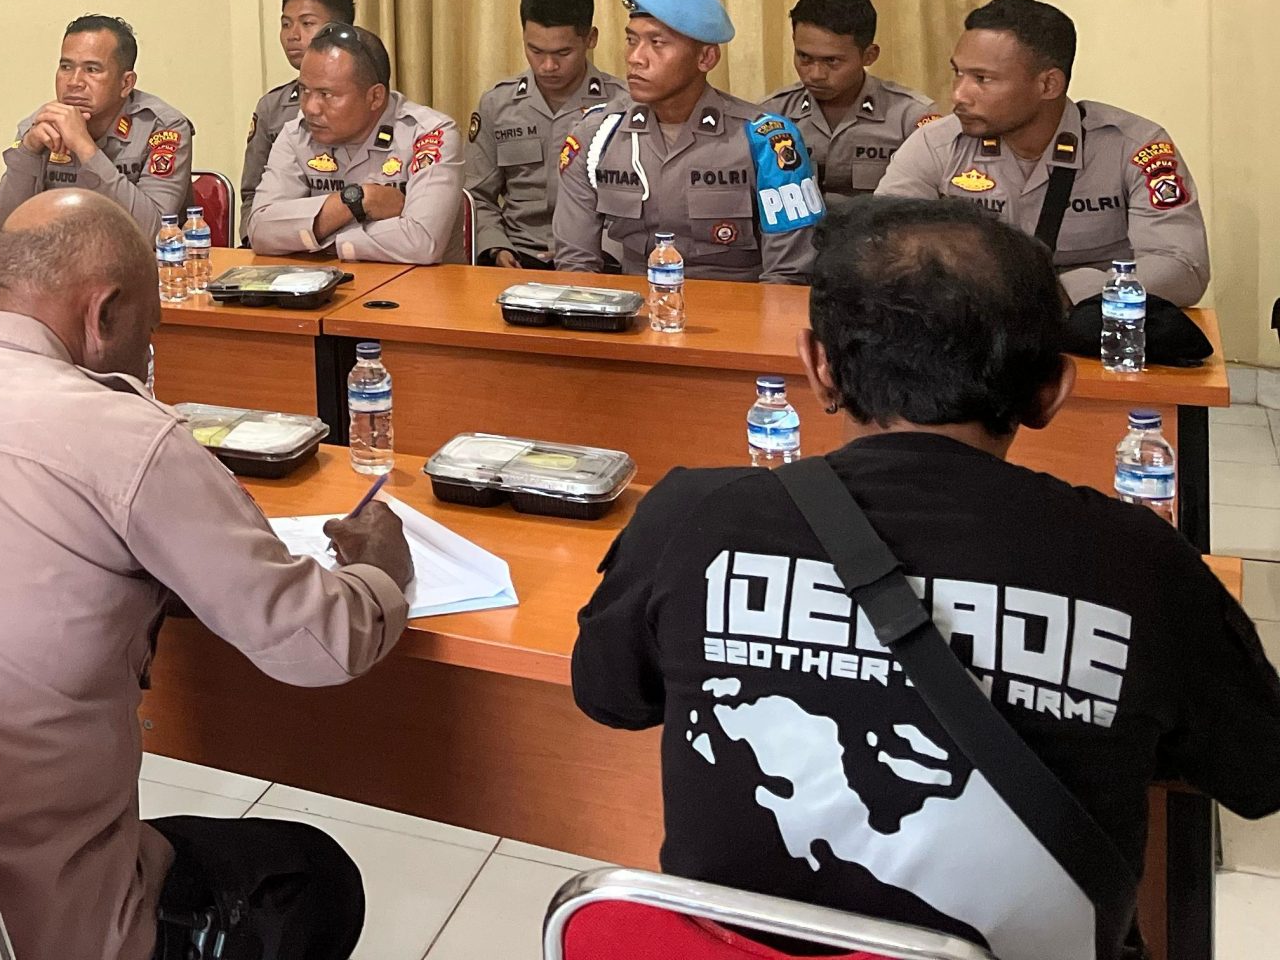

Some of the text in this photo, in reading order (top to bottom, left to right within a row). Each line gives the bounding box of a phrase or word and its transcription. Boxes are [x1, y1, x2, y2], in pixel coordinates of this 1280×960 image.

[494, 124, 538, 141] CHRIS M
[1133, 143, 1171, 163] POLRES
[1145, 160, 1173, 173] PAPUA
[690, 169, 748, 186] POLRI
[1007, 678, 1118, 729] ARMS
